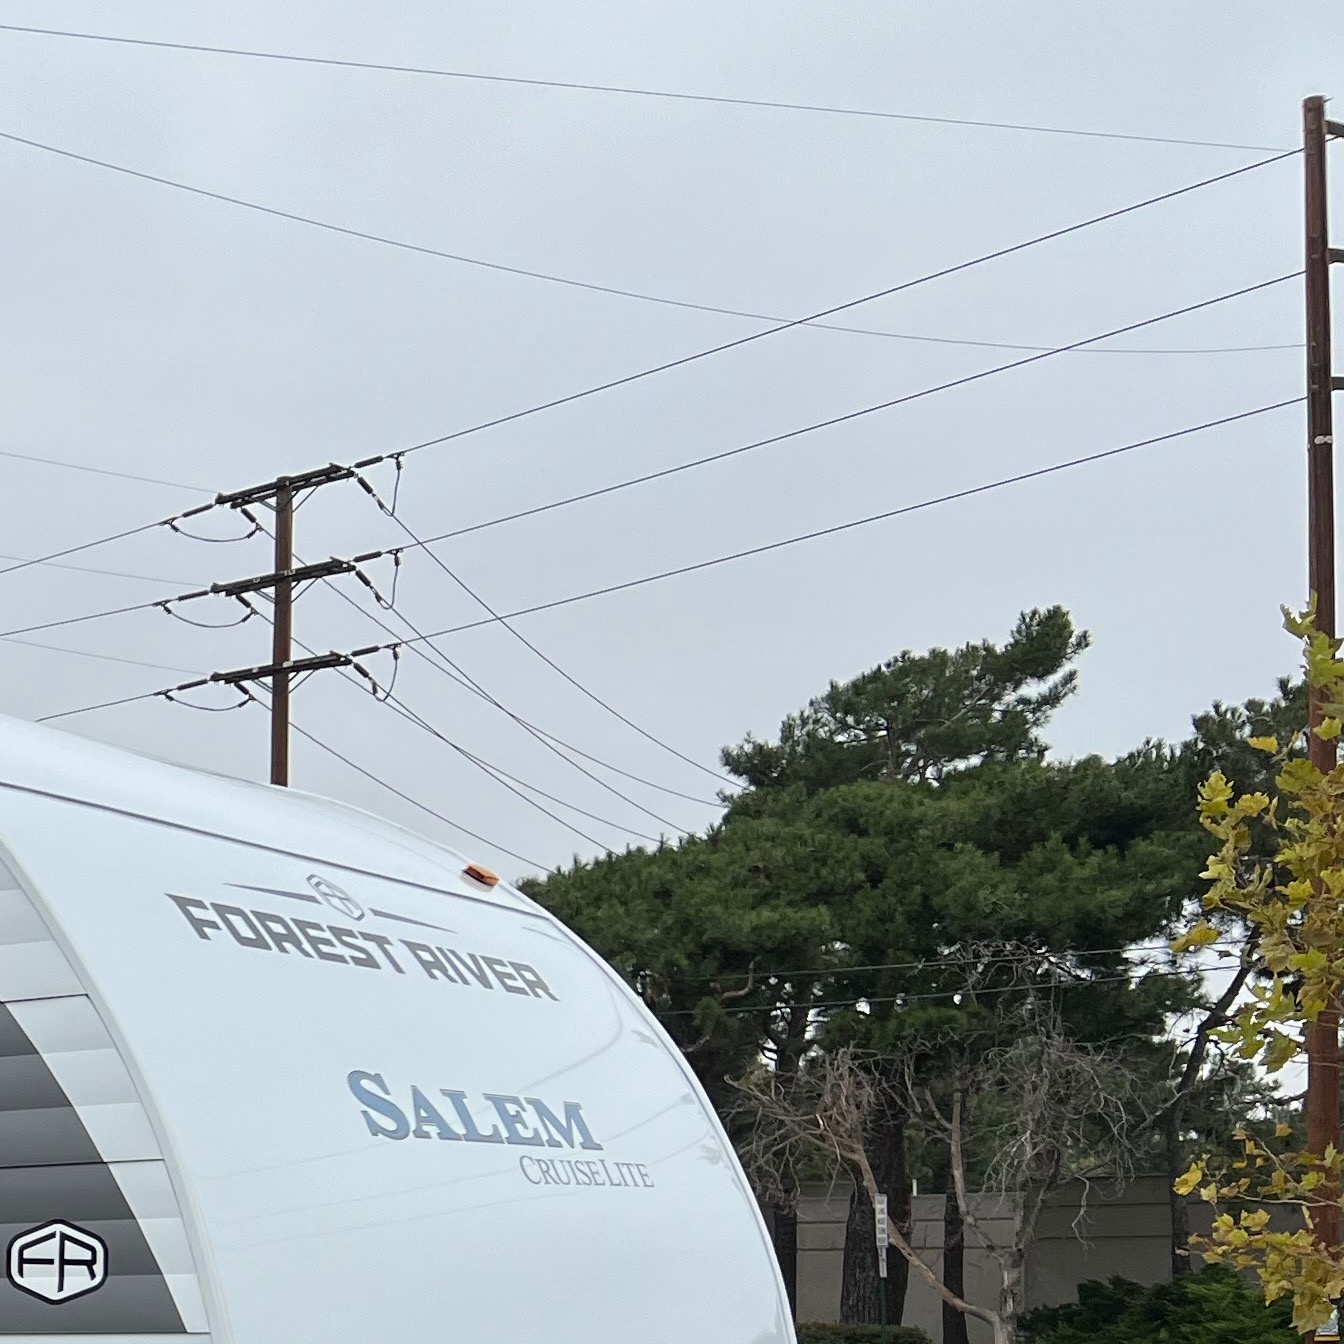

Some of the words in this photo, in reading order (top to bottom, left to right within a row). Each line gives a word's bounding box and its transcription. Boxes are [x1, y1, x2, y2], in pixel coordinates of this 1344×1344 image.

[164, 893, 406, 975] FOREST
[398, 938, 561, 1001] RIVER
[347, 1070, 605, 1151] SALEM
